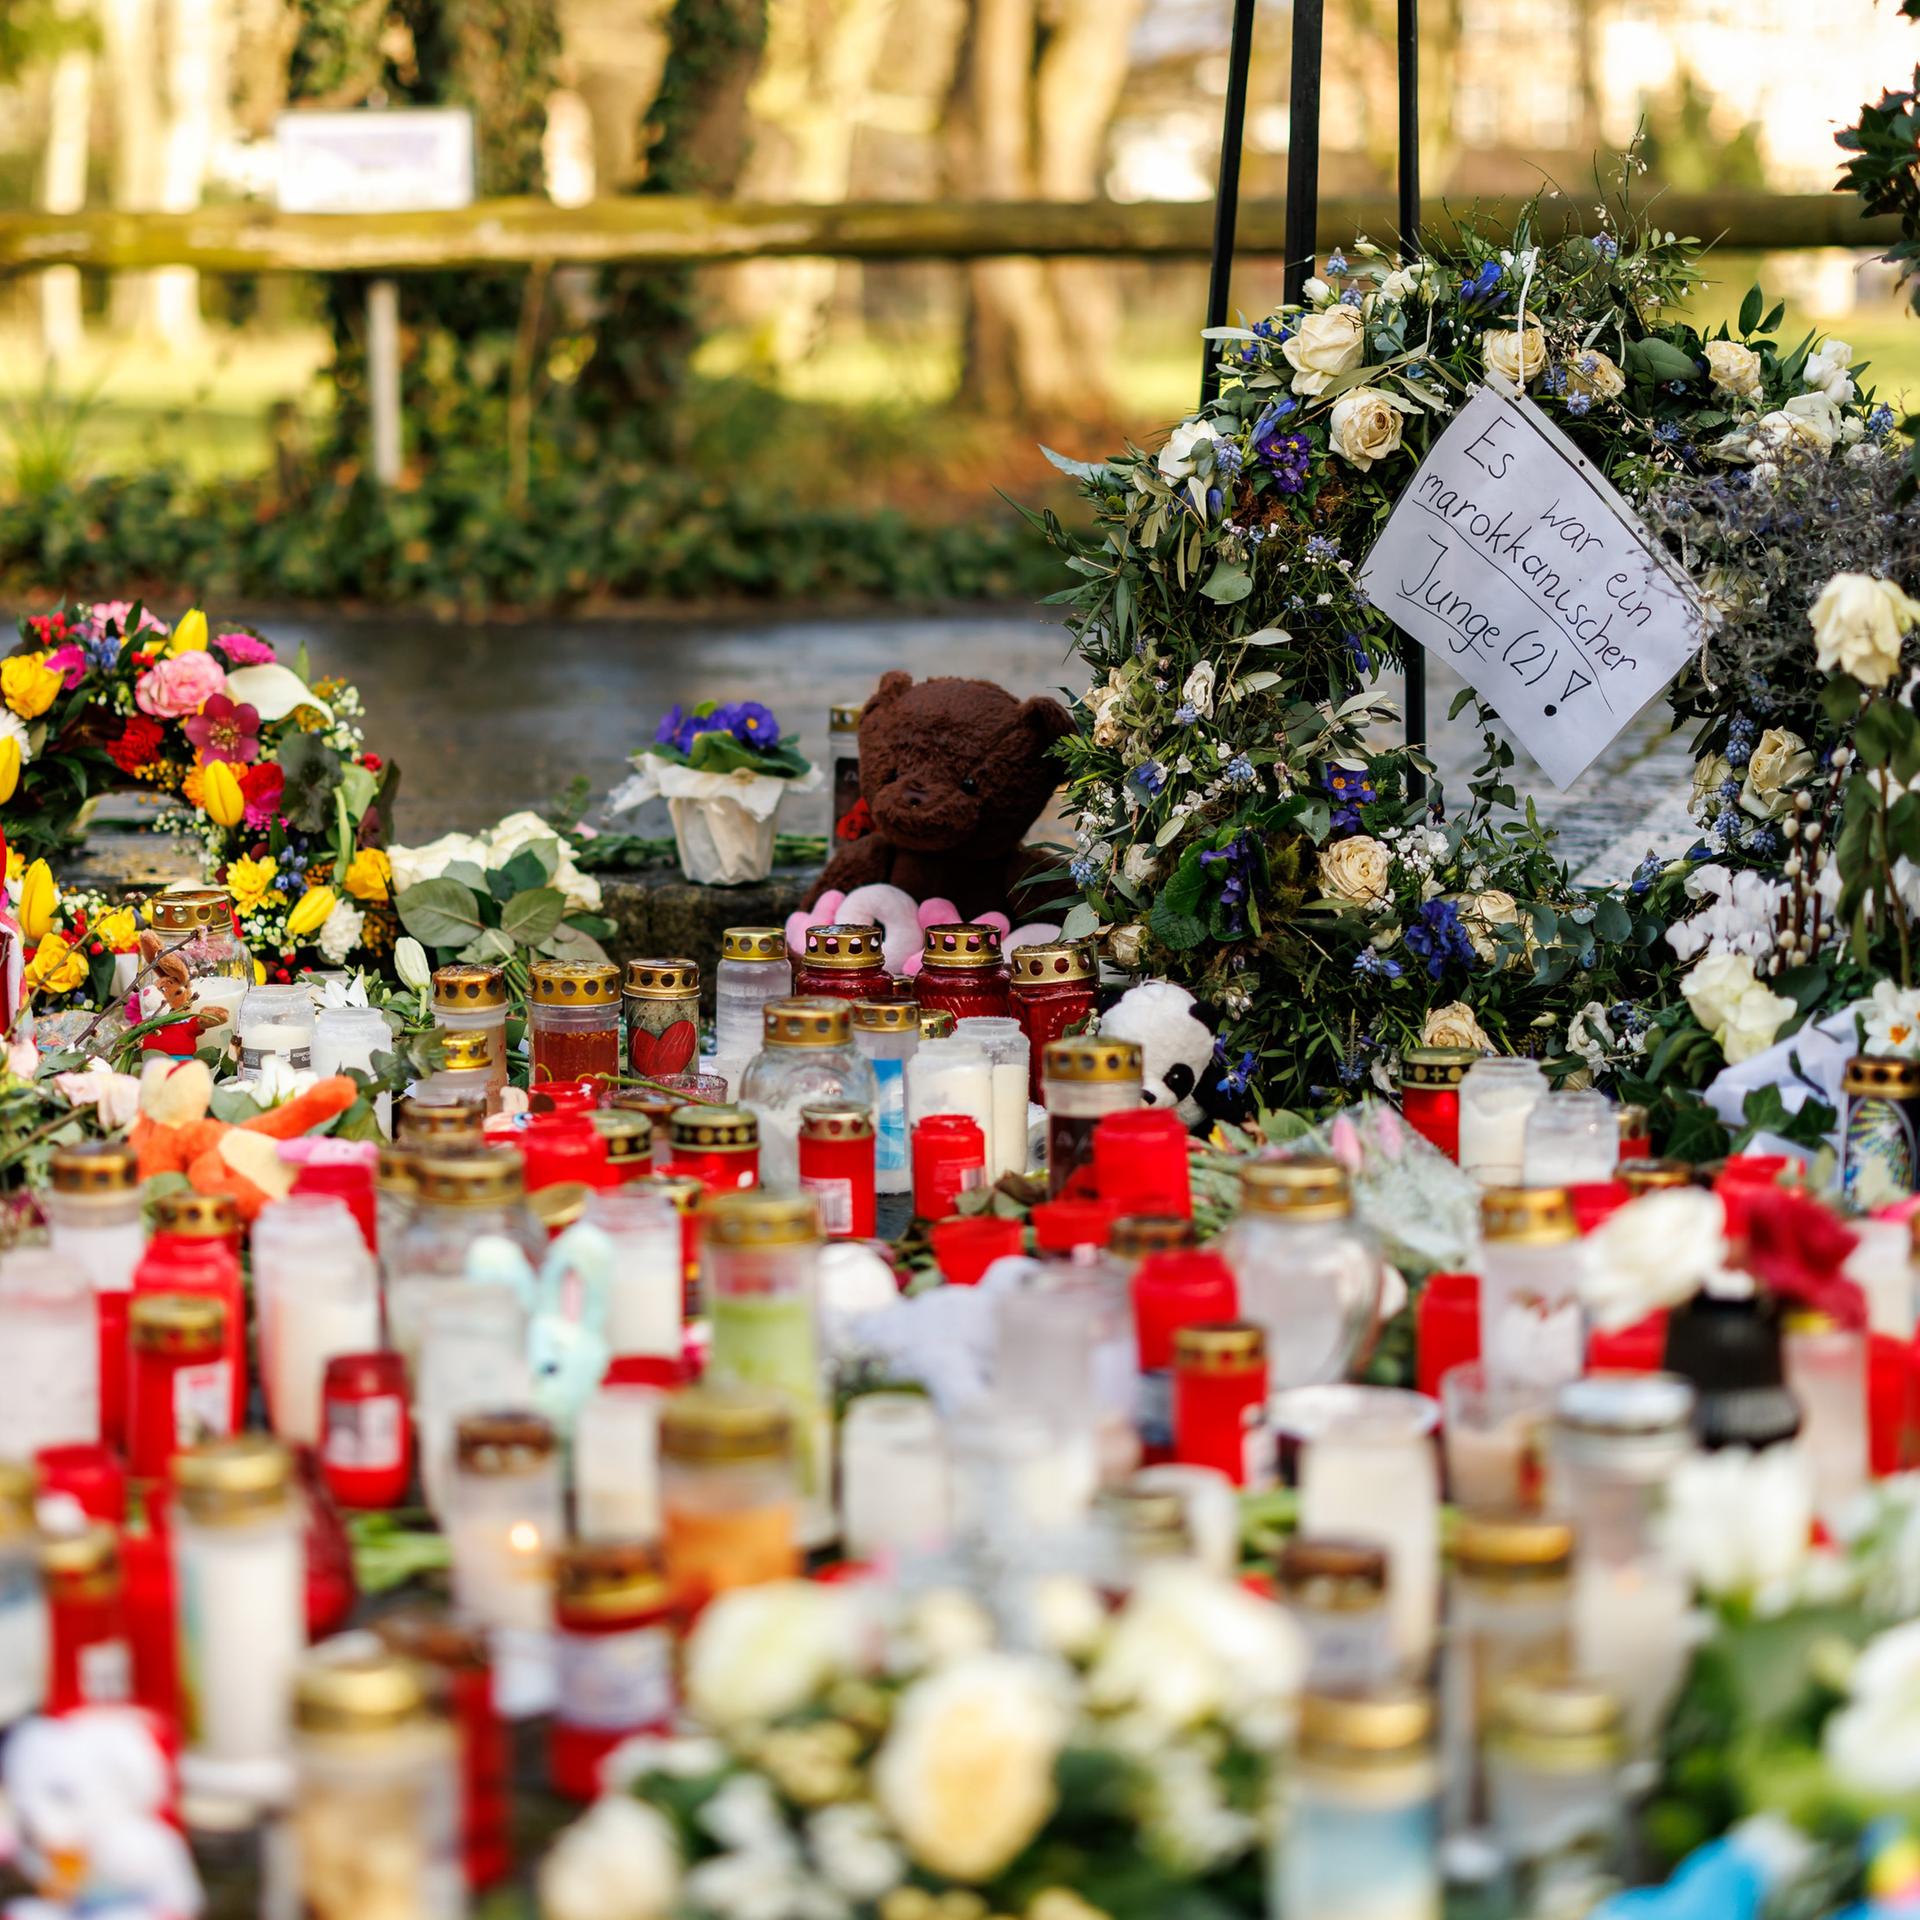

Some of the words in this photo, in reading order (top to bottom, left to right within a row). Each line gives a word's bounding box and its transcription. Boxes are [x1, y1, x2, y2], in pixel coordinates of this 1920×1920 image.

[1400, 534, 1501, 654] Junge
[1418, 471, 1637, 674] marokkanischer
[1463, 415, 1516, 480] Es
[1539, 498, 1604, 554] war
[1604, 572, 1652, 627] ein
